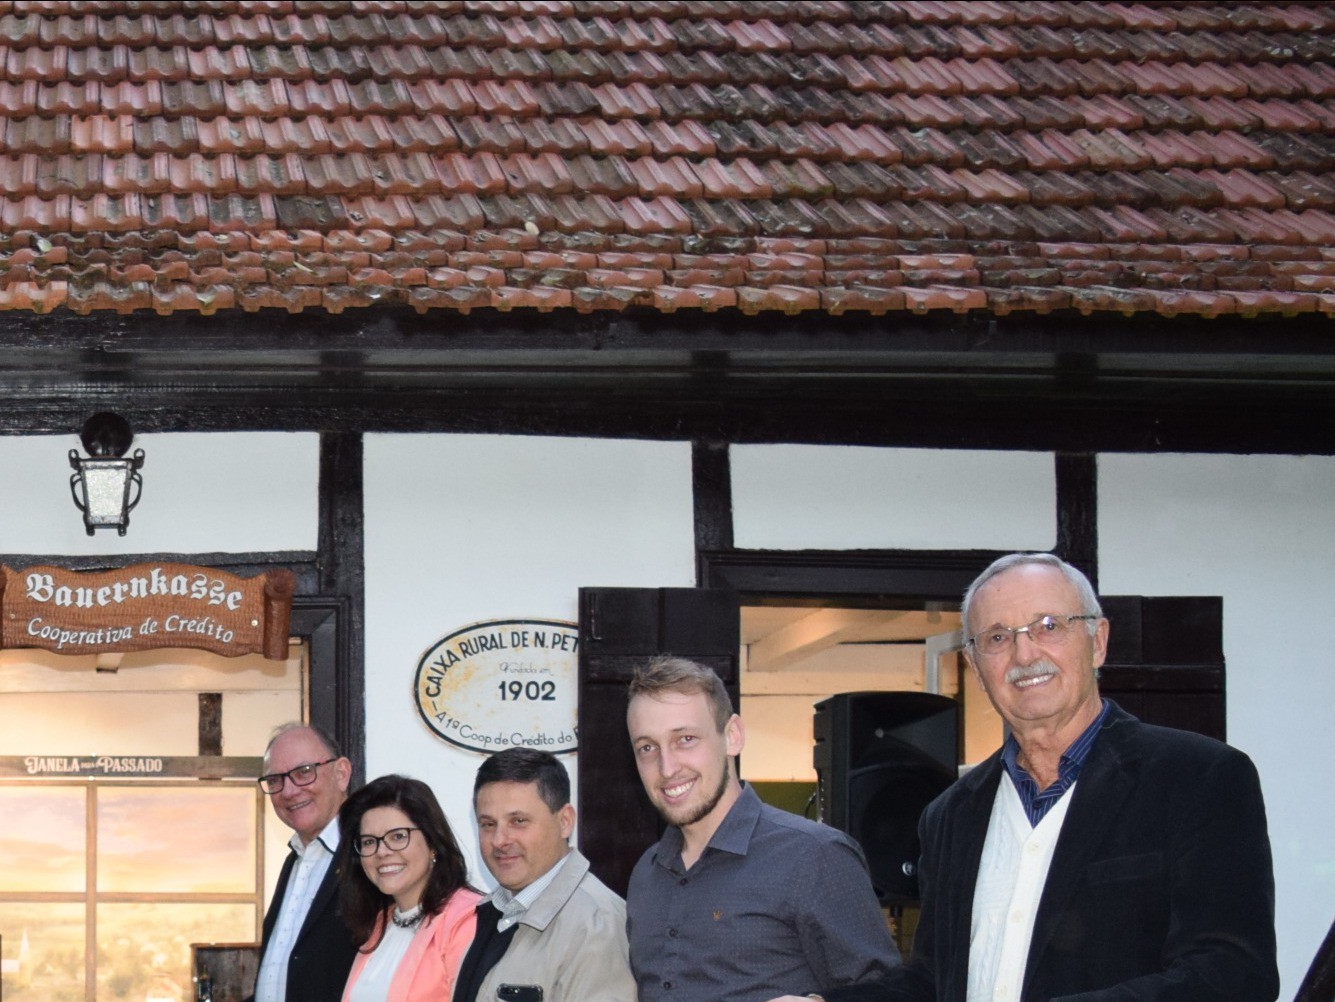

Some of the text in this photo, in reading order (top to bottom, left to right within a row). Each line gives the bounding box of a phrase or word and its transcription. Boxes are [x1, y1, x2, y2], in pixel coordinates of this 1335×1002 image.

[25, 568, 243, 611] Bauernkasse
[27, 614, 234, 649] Cooperativa de Crédito
[425, 649, 461, 698] CAIXA
[458, 632, 508, 659] RURAL
[511, 631, 529, 648] DE
[534, 631, 549, 649] N.
[498, 680, 556, 701] 1902
[435, 711, 447, 723] A
[459, 724, 493, 747] Coop
[494, 732, 509, 745] de
[510, 732, 555, 746] Crédito
[557, 731, 573, 744] do
[24, 756, 80, 774] JANELA
[96, 756, 163, 773] PASSADO
